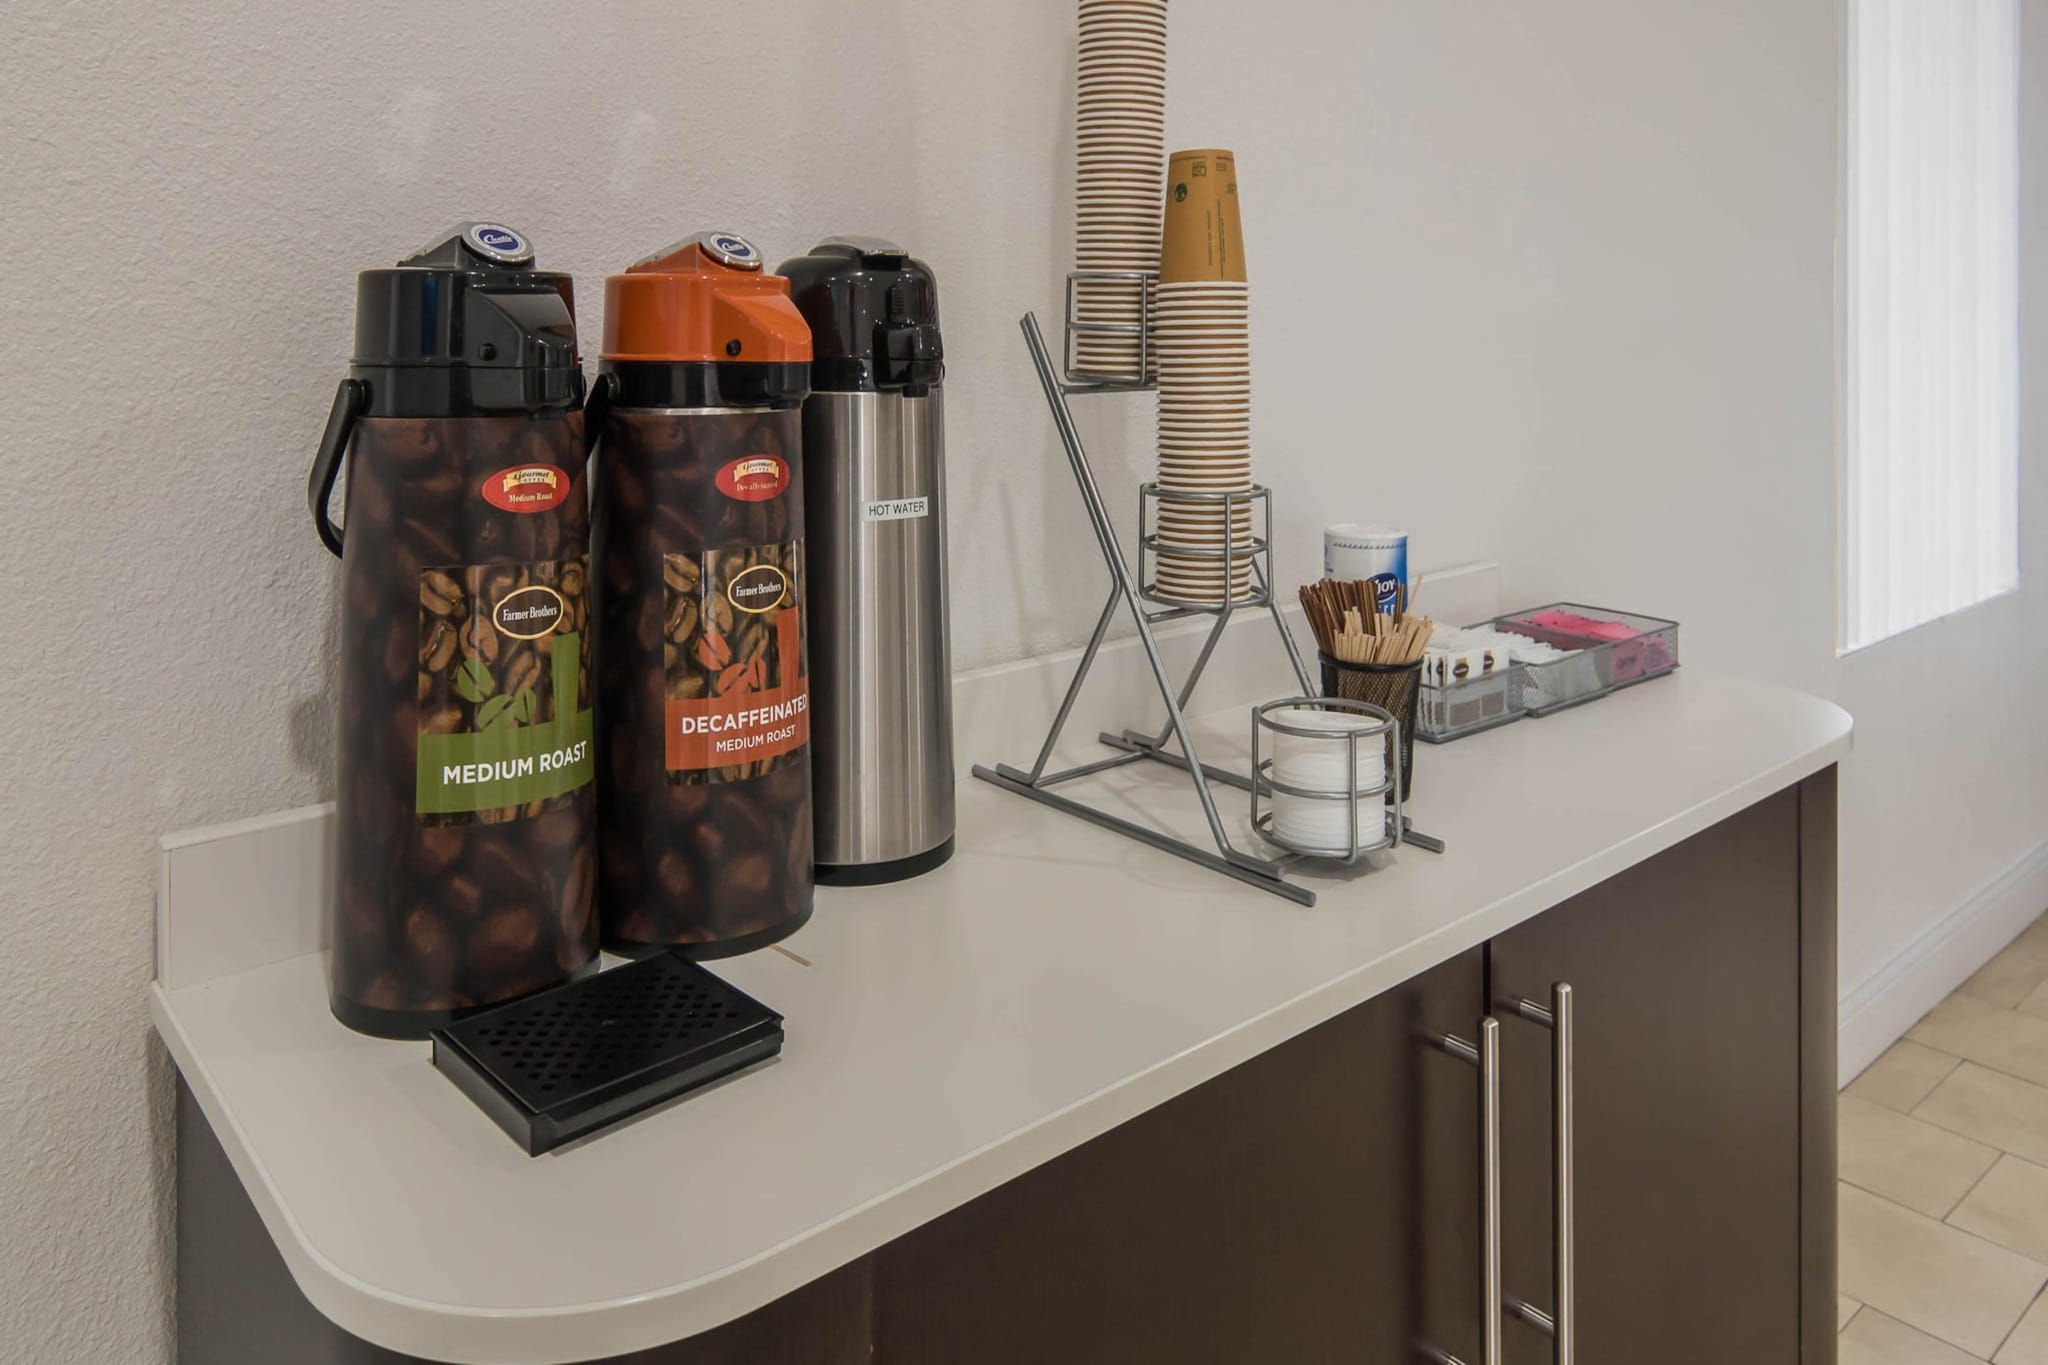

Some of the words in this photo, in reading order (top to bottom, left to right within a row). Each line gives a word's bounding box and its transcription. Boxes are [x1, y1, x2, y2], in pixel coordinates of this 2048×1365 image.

[508, 493, 535, 503] Medium
[868, 503, 890, 517] HOT
[892, 500, 925, 515] WATER
[735, 585, 758, 598] Farmer
[758, 581, 782, 595] Brothers
[503, 608, 529, 622] Farmer
[529, 604, 557, 618] Brothers
[681, 693, 808, 735] DECAFFEINATED
[715, 735, 765, 753] MEDIUM
[766, 724, 796, 744] ROAST
[443, 756, 533, 785] MEDIUM
[540, 740, 587, 773] ROAST
